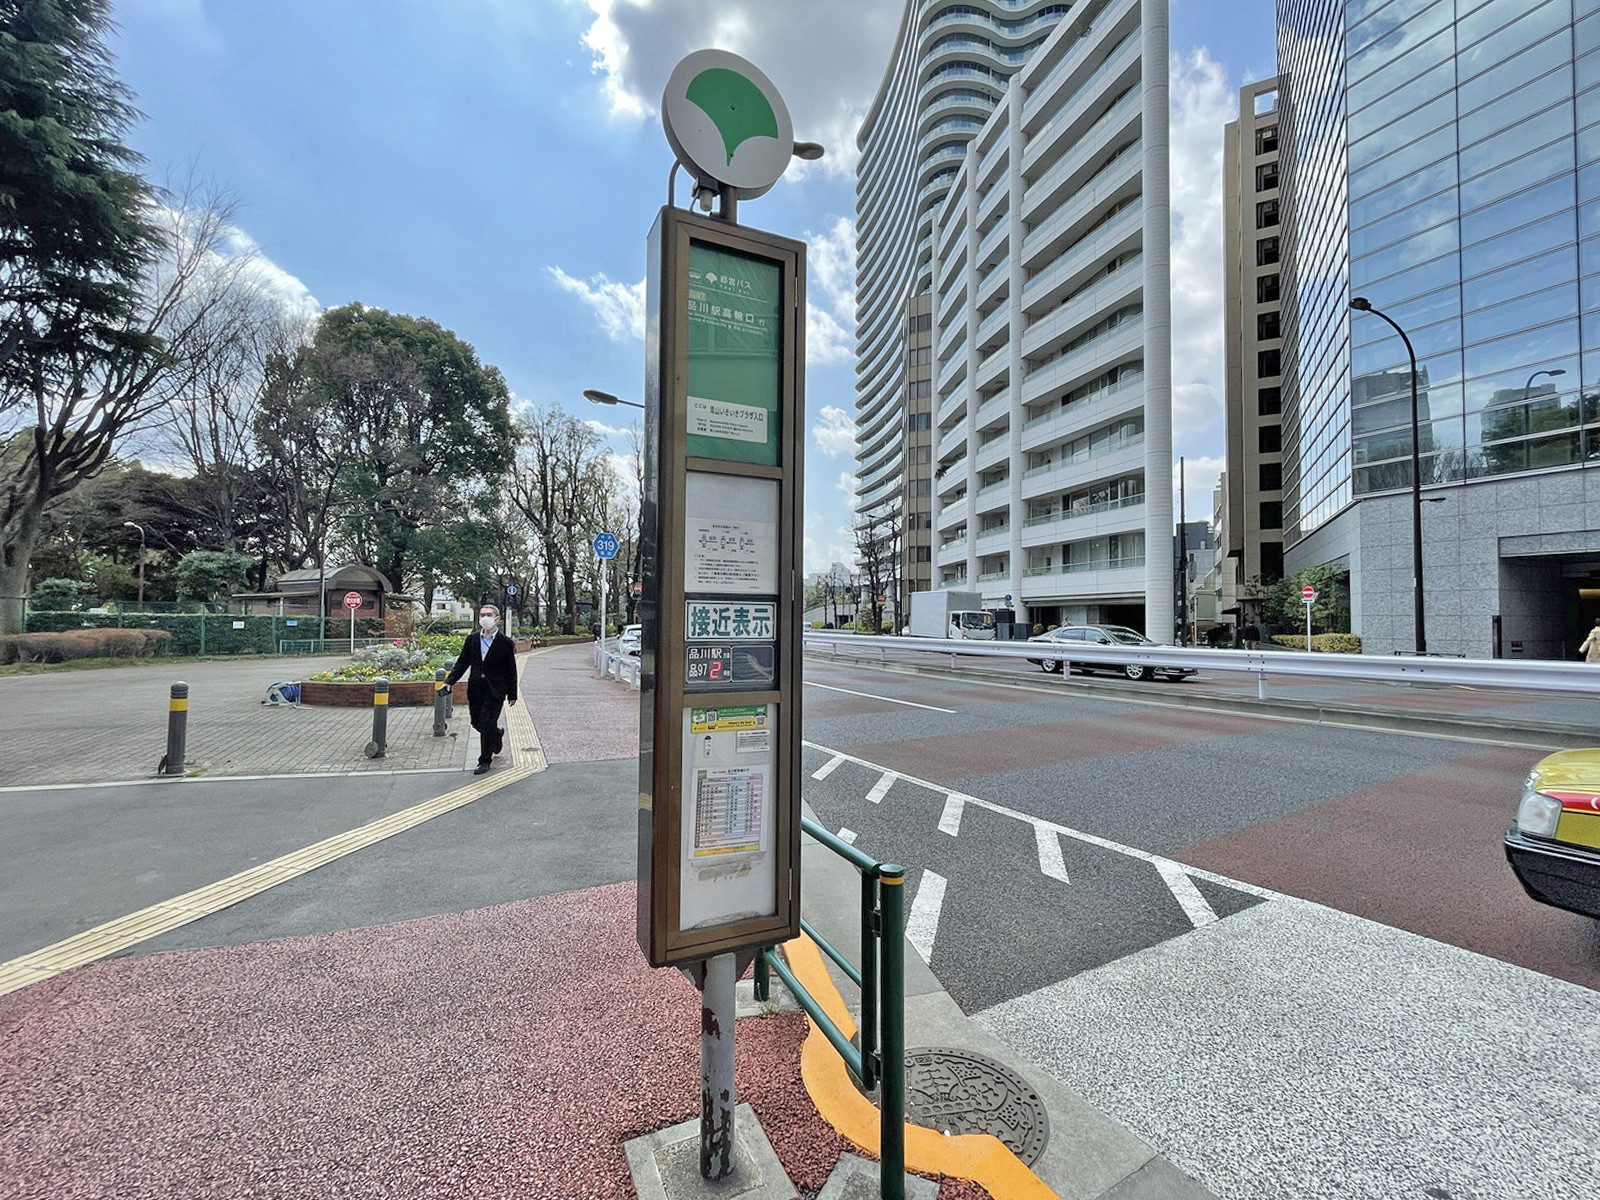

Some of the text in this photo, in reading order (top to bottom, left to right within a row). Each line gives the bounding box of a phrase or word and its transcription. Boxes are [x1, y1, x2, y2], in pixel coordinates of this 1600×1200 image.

[688, 300, 754, 323] 品川駅高輪口
[597, 540, 614, 551] 319
[691, 606, 770, 636] 接近表示
[689, 663, 708, 677] 品97
[709, 661, 722, 679] 2
